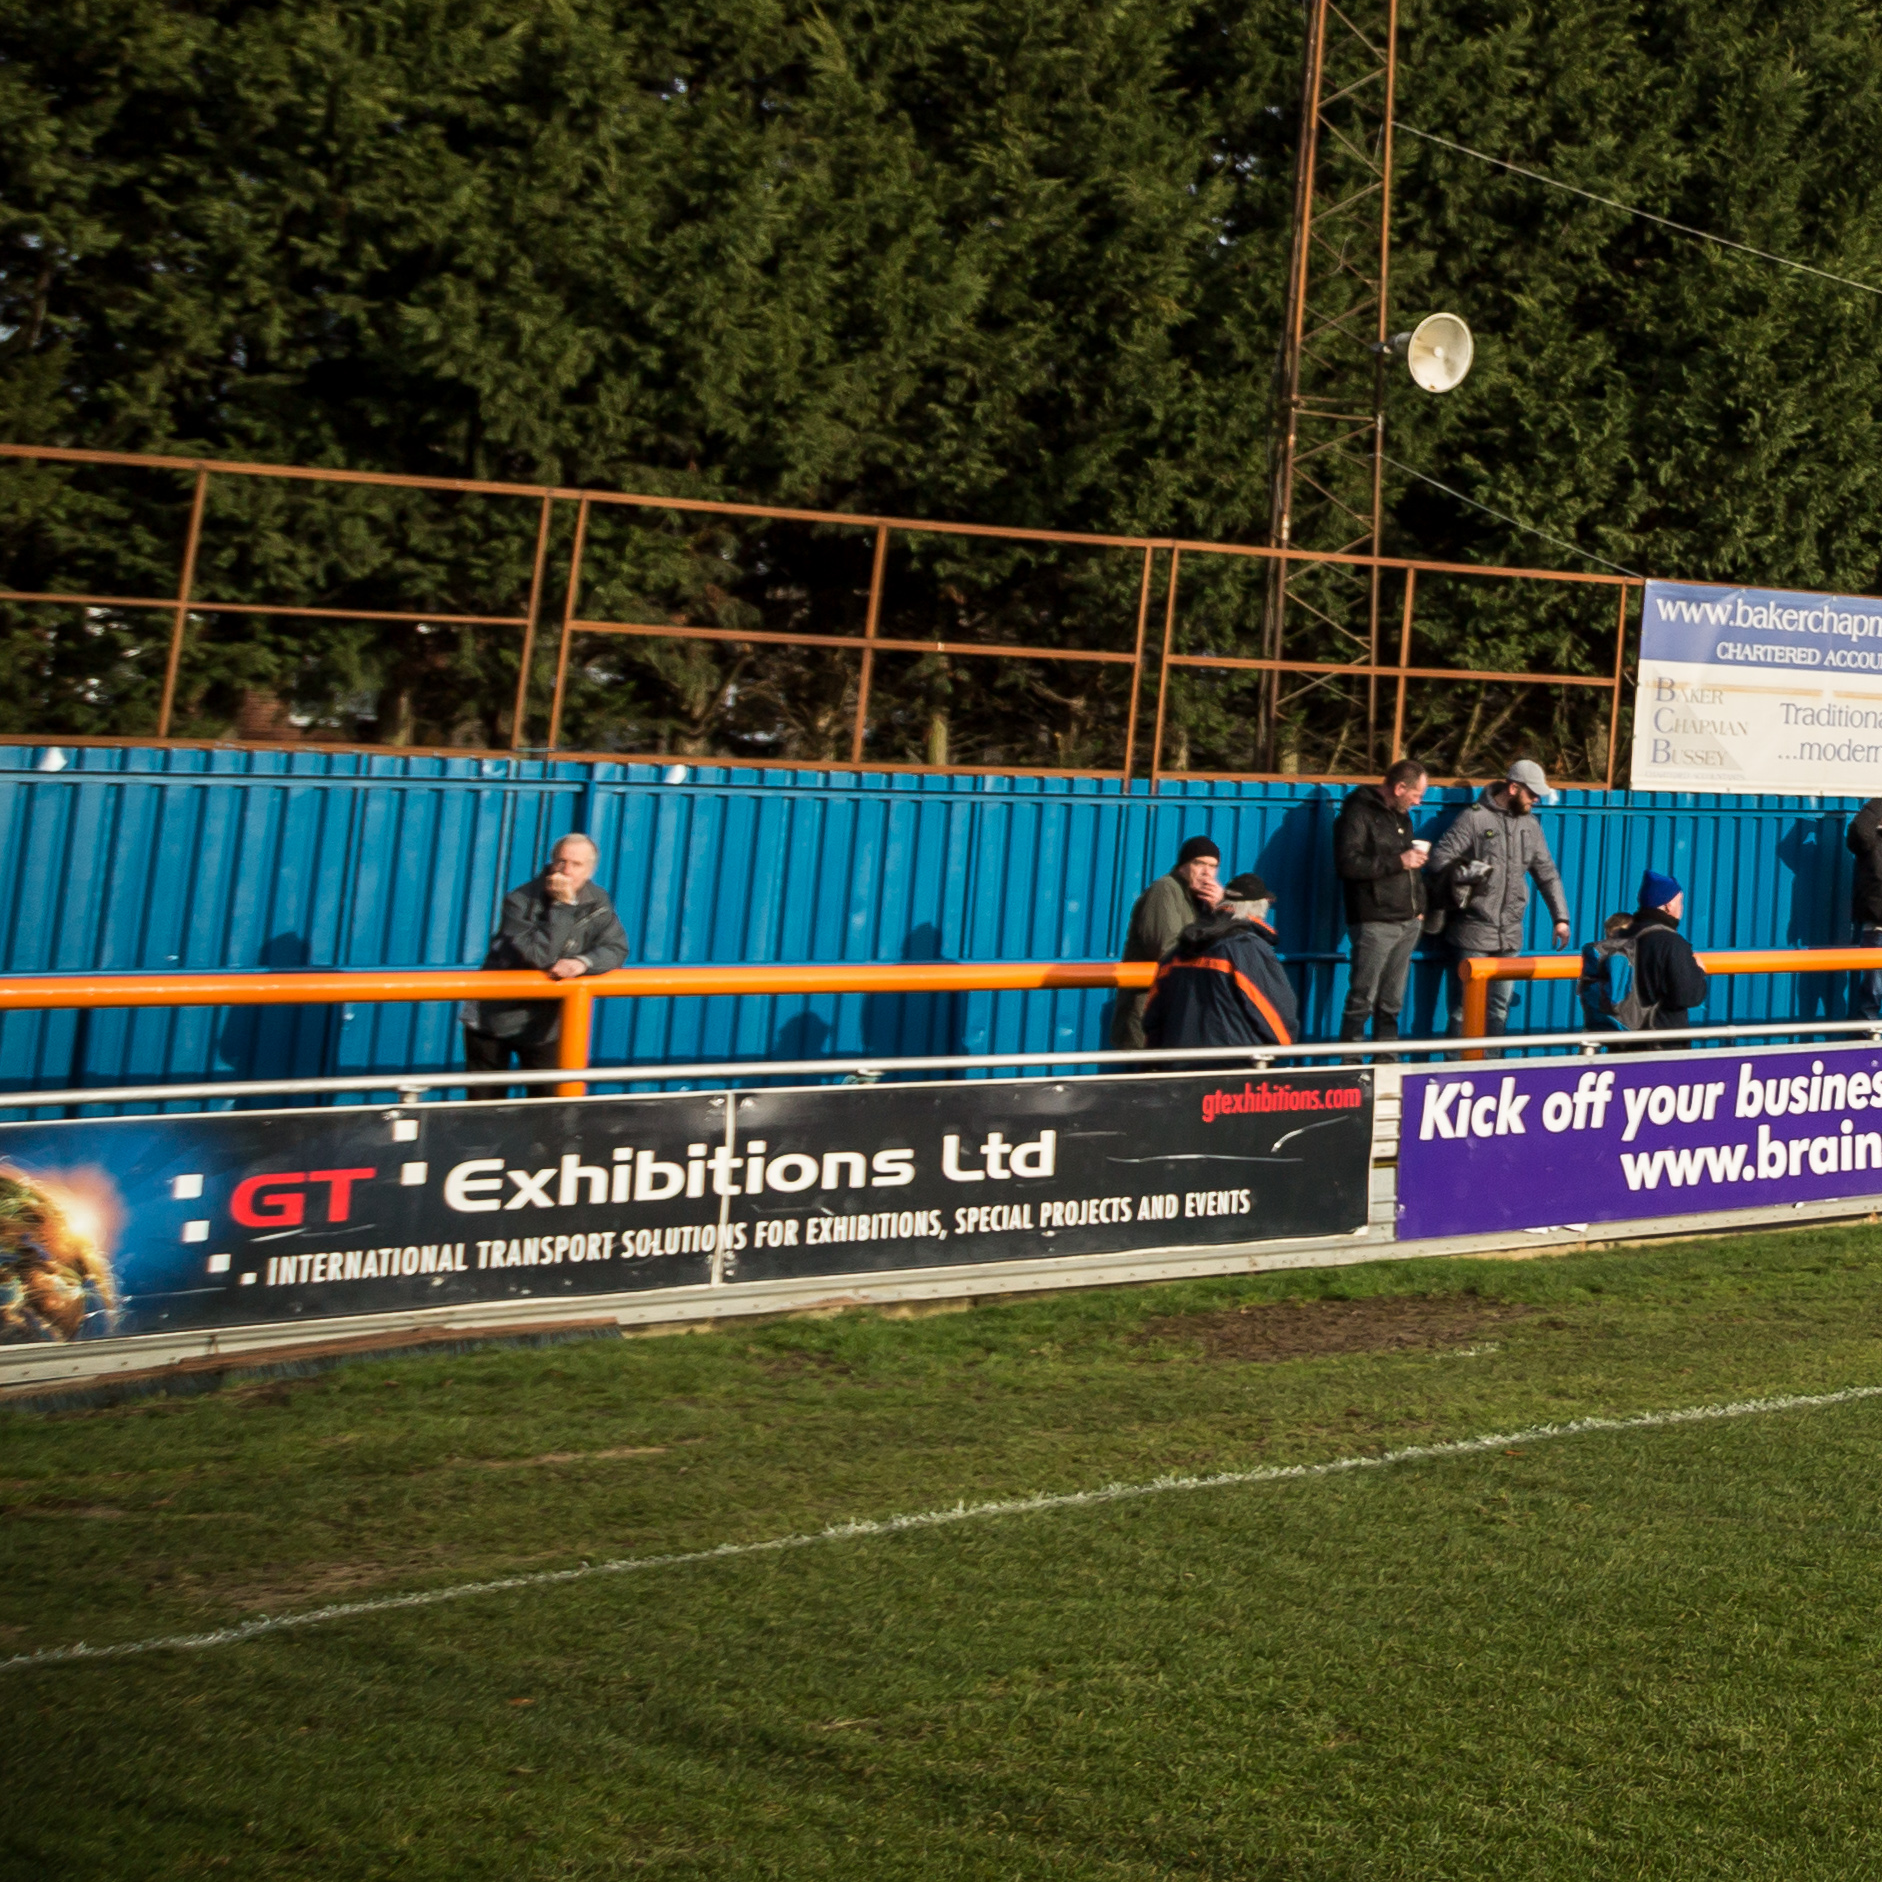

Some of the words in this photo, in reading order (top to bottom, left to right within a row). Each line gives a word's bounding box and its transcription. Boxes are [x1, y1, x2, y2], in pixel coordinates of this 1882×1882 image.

[1716, 641, 1821, 667] CHARTERED
[1202, 1080, 1362, 1122] gtexhibitions.com
[1418, 1076, 1524, 1141] Kick
[1541, 1069, 1614, 1134] off
[1621, 1078, 1723, 1141] your
[230, 1167, 378, 1229] GT
[444, 1139, 917, 1215] Exhibitions
[942, 1129, 1057, 1183] Ltd
[267, 1242, 468, 1287] INTERNATIONAL
[476, 1231, 615, 1269] TRANSPORT
[620, 1221, 748, 1259] SOLUTIONS
[754, 1217, 799, 1248] FOR
[804, 1206, 949, 1246] EXHIBITIONS,
[954, 1200, 1035, 1234] SPECIAL
[1039, 1197, 1133, 1228] PROJECTS
[1137, 1194, 1179, 1221] AND
[1185, 1188, 1251, 1217] EVENTS
